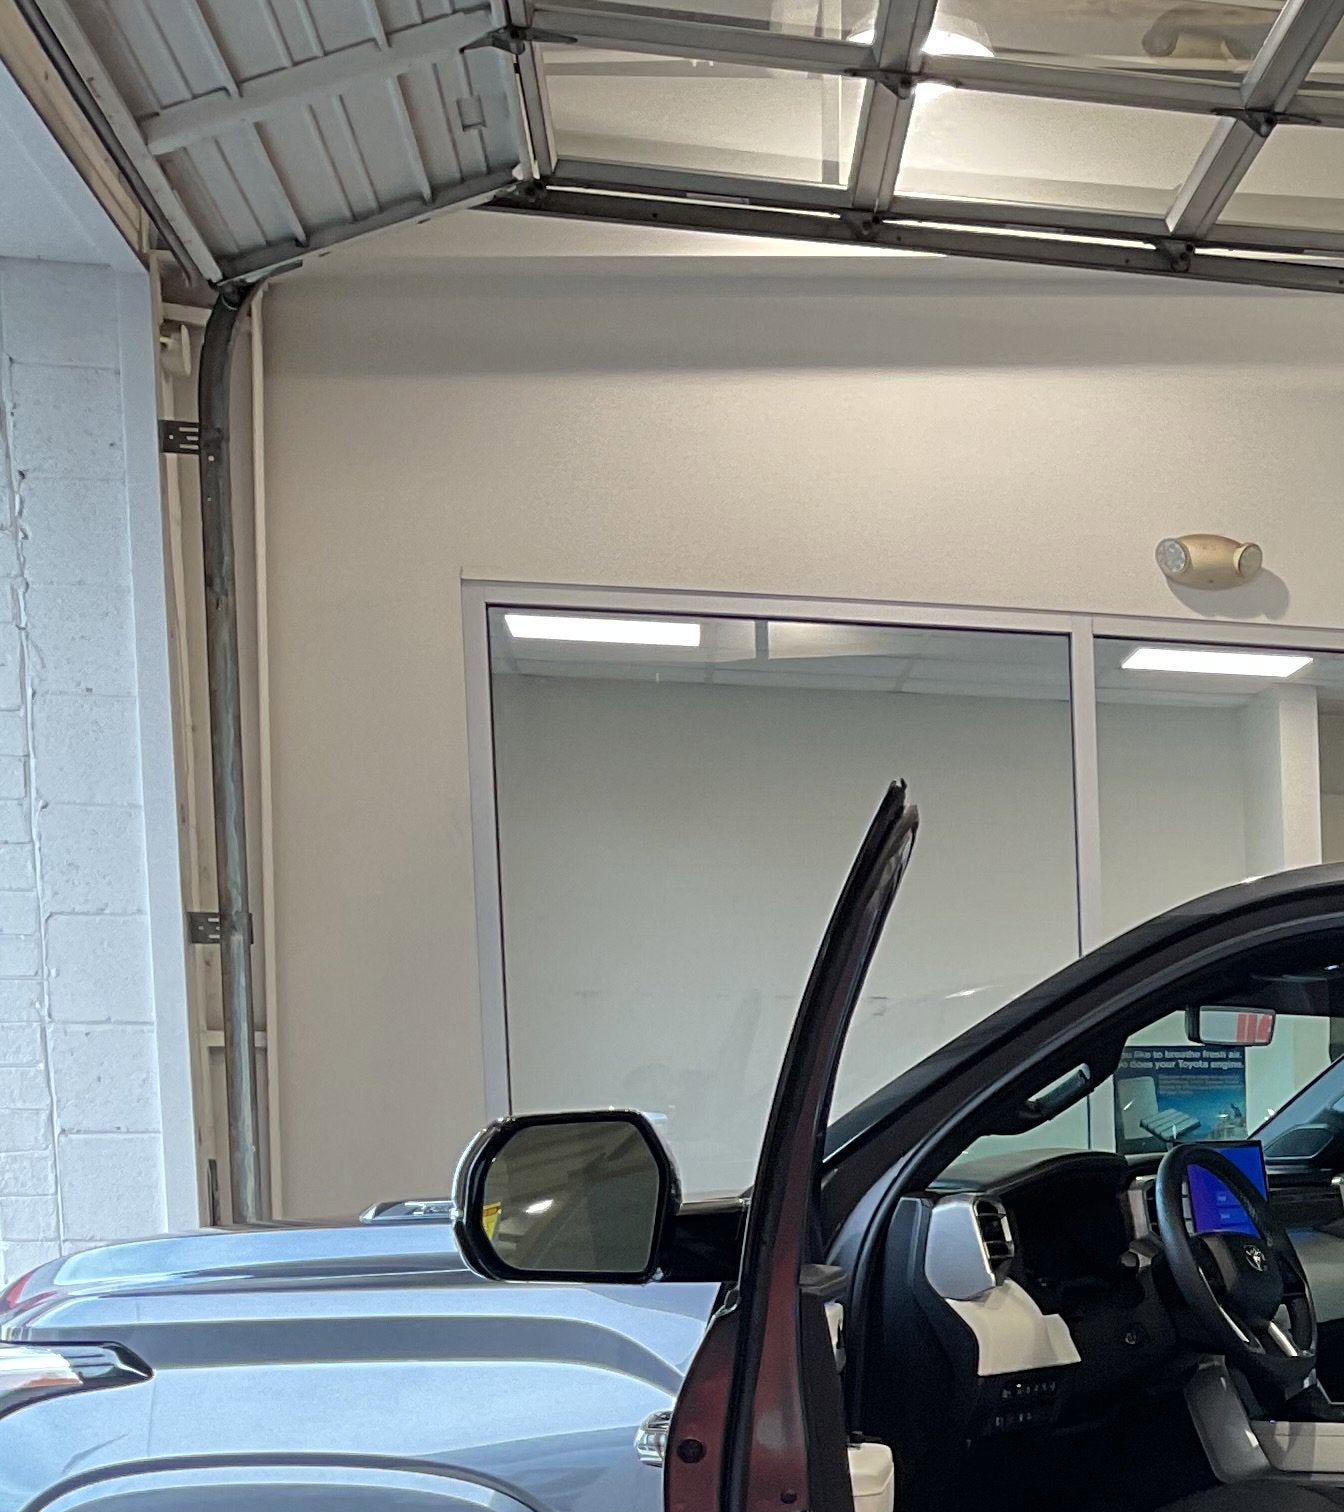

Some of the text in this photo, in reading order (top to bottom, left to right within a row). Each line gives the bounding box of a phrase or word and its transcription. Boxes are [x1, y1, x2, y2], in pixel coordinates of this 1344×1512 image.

[1153, 1051, 1163, 1059] to
[1164, 1050, 1201, 1059] breathe
[1202, 1050, 1227, 1059] fresh
[1130, 1061, 1153, 1069] does
[1155, 1061, 1176, 1070] your
[1178, 1060, 1209, 1070] Toyota
